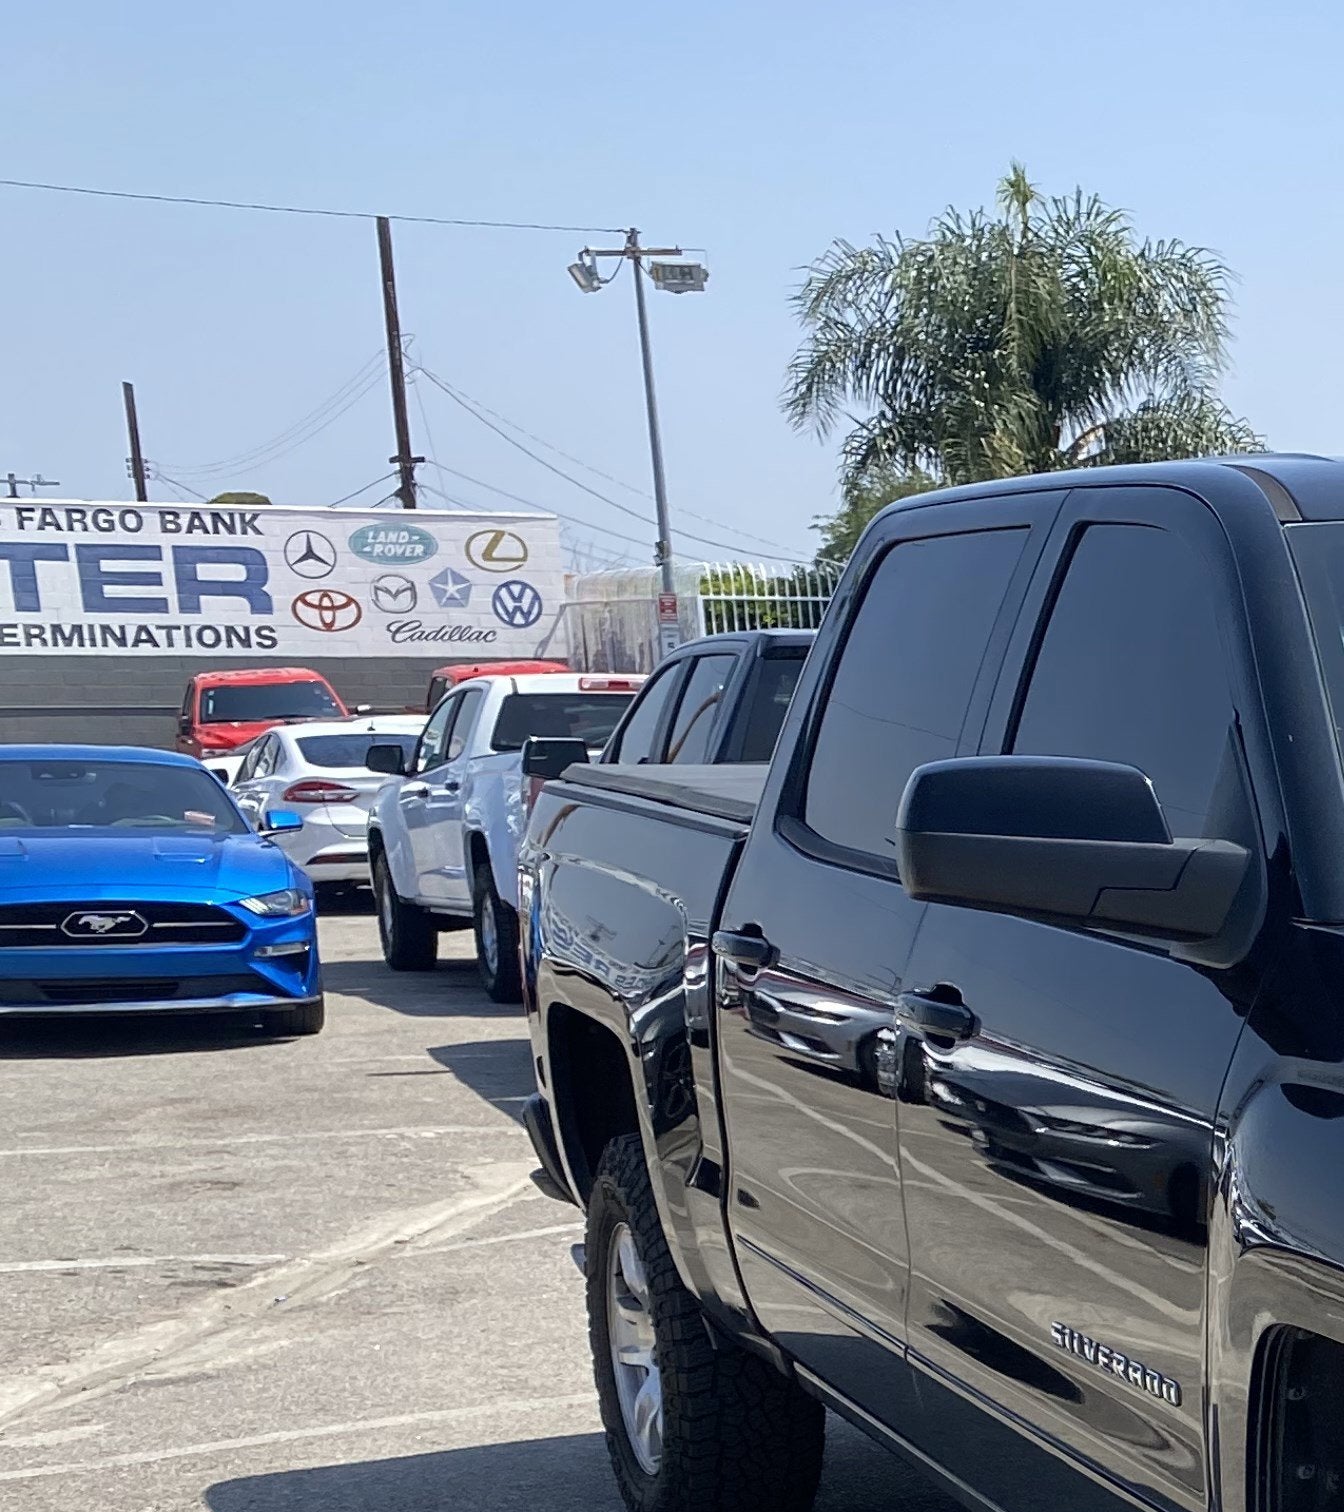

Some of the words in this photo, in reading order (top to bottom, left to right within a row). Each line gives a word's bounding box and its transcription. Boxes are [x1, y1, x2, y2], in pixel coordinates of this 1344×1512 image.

[15, 507, 144, 533] FARGO
[159, 510, 265, 536] BANK
[0, 542, 274, 615] TER
[0, 624, 278, 649] ERMINATIONS
[386, 619, 498, 644] Cadillac
[1051, 1320, 1182, 1407] SILVERADO
